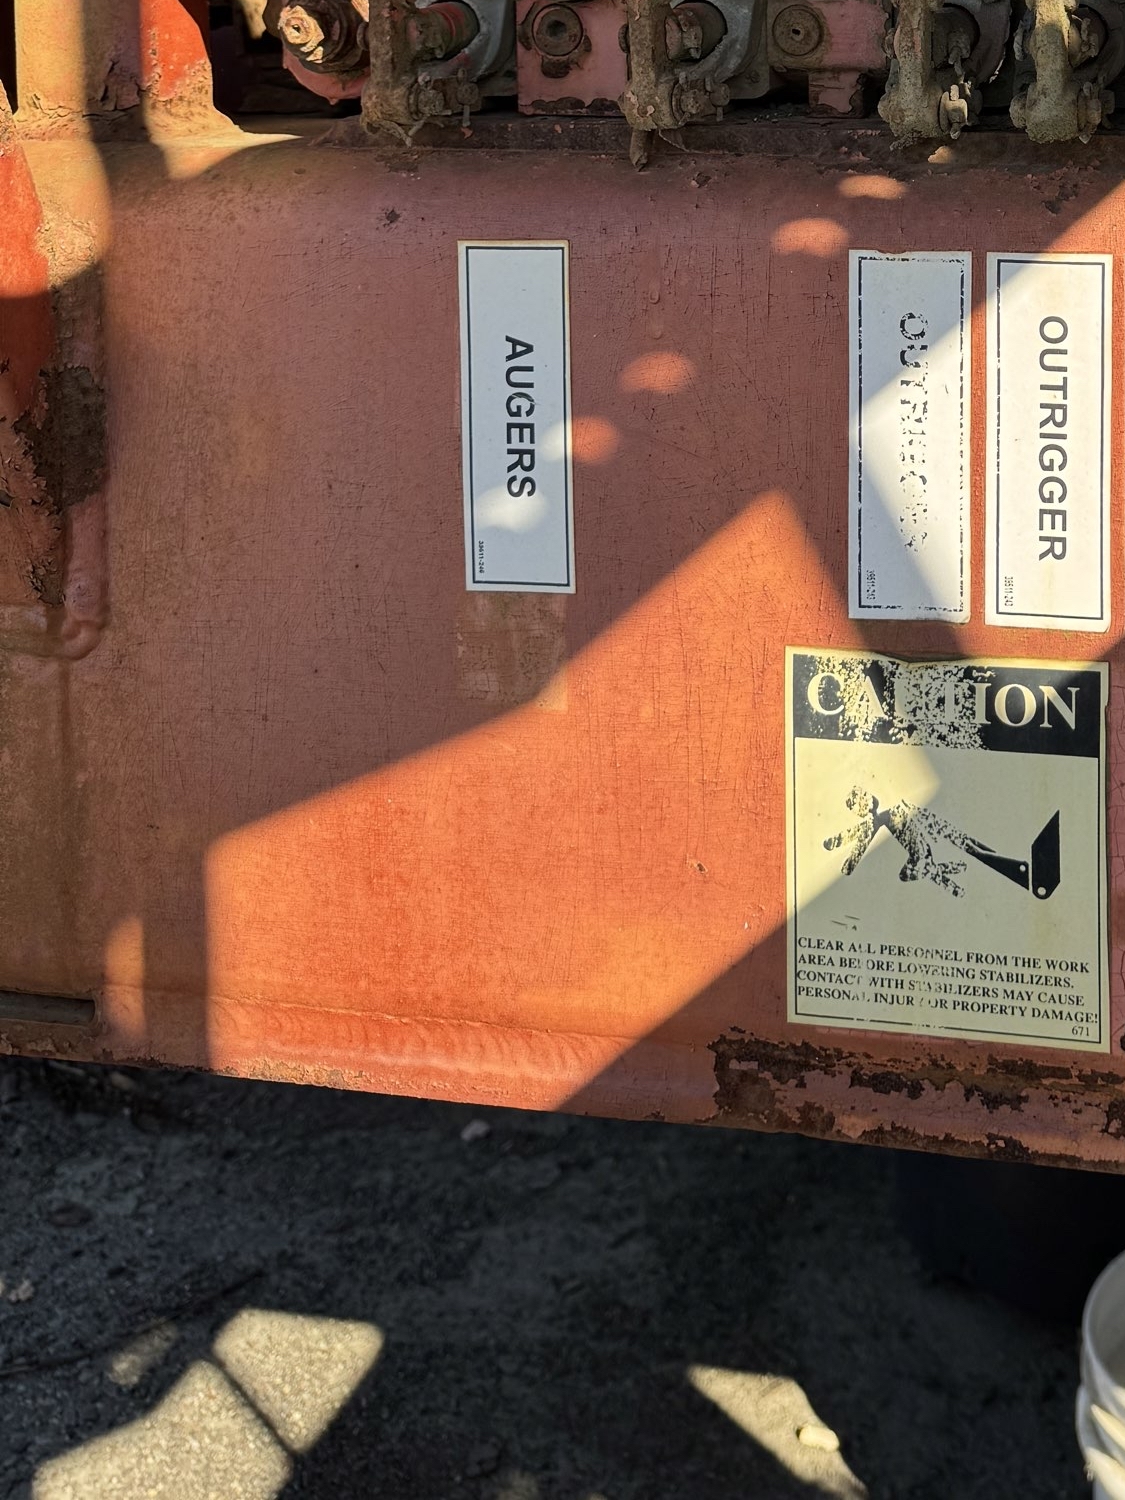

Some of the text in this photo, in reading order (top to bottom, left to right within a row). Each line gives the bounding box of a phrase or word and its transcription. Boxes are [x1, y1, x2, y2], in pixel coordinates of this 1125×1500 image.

[505, 335, 536, 498] AUGERS
[1038, 316, 1069, 562] OUTRIGGER
[797, 936, 844, 952] CLEAR
[880, 944, 962, 962] PERSONNEL
[966, 952, 1008, 966] FROM
[1012, 956, 1041, 969] THE
[1046, 959, 1090, 973] WORK
[798, 954, 835, 967] AREA
[898, 962, 975, 979] LOWERING
[979, 969, 1074, 989] STABILIZERS.
[874, 992, 923, 1008] INJUR
[952, 1000, 1028, 1017] PROPERTY
[1031, 1007, 1098, 1024] DAMAGE!
[1003, 989, 1034, 1002] MAY
[1037, 992, 1085, 1007] CAUSE
[1071, 1026, 1090, 1037] 671
